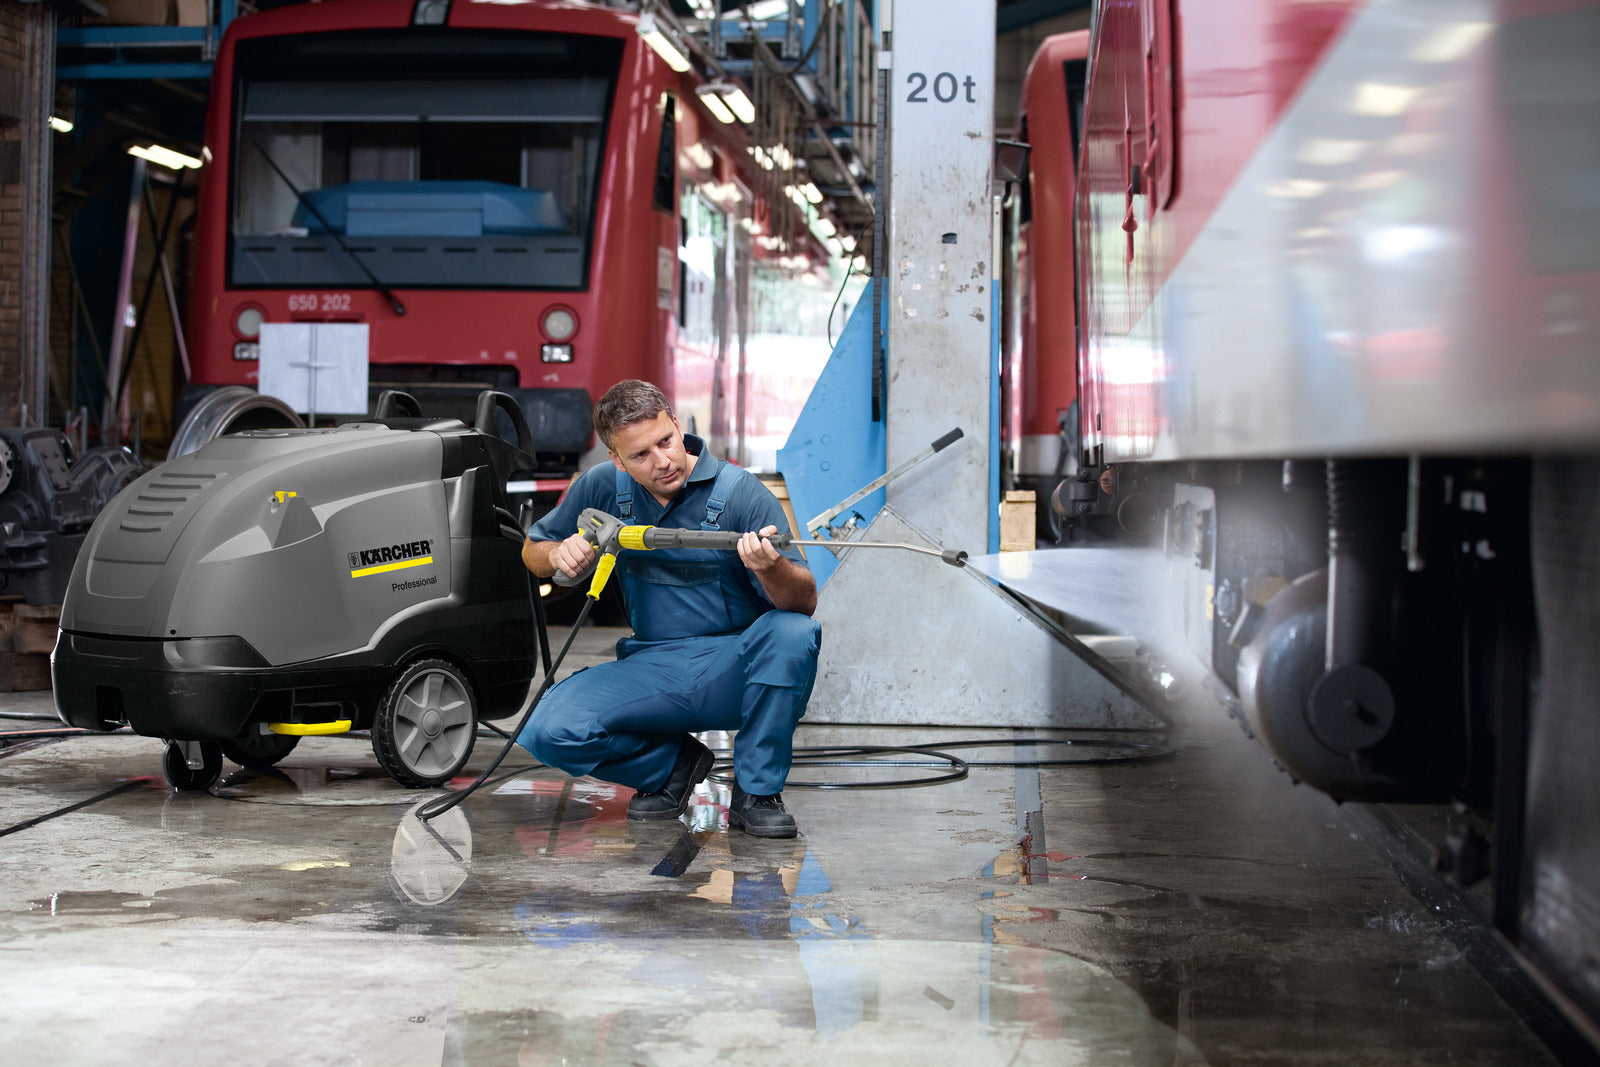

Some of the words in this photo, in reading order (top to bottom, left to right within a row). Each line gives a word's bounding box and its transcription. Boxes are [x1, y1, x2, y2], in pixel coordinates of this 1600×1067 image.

[906, 72, 976, 103] 20t
[288, 294, 318, 311] 650
[322, 294, 351, 311] 202
[391, 576, 438, 592] Professional
